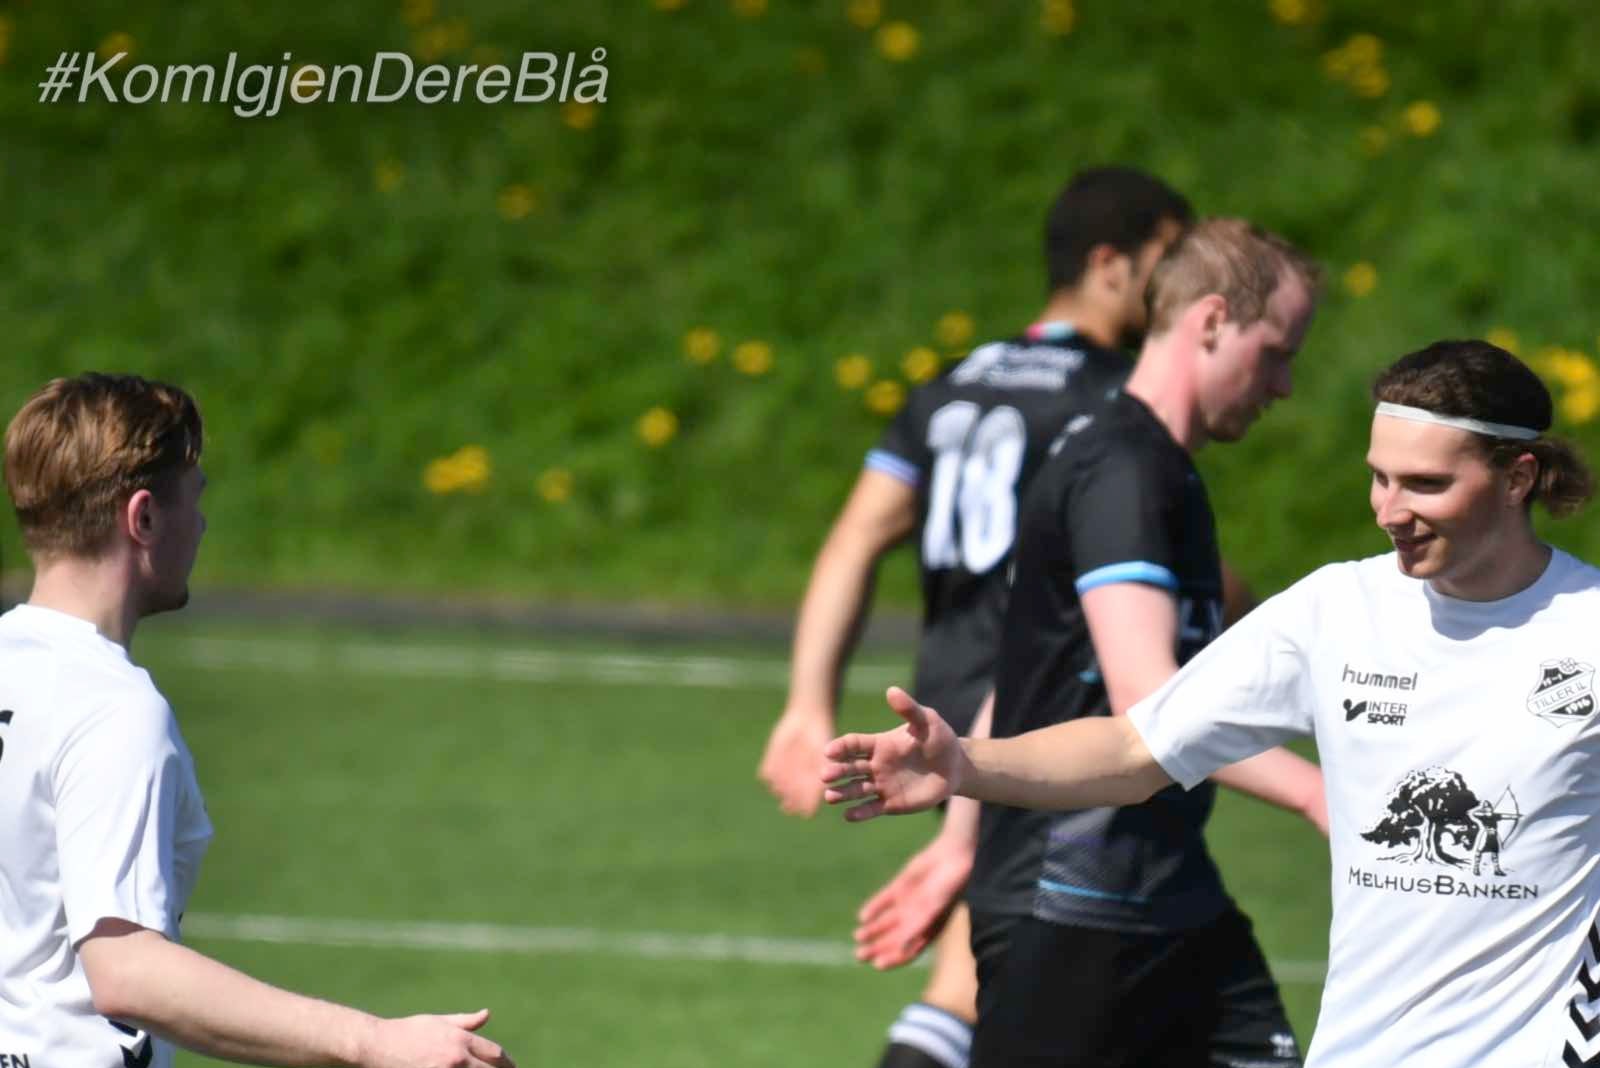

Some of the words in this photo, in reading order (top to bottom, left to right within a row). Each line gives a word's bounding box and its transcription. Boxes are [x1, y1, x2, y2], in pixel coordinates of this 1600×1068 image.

[921, 400, 1026, 573] 18
[1342, 663, 1418, 691] hummel
[1368, 700, 1408, 715] INTER
[1367, 712, 1406, 727] SPORT
